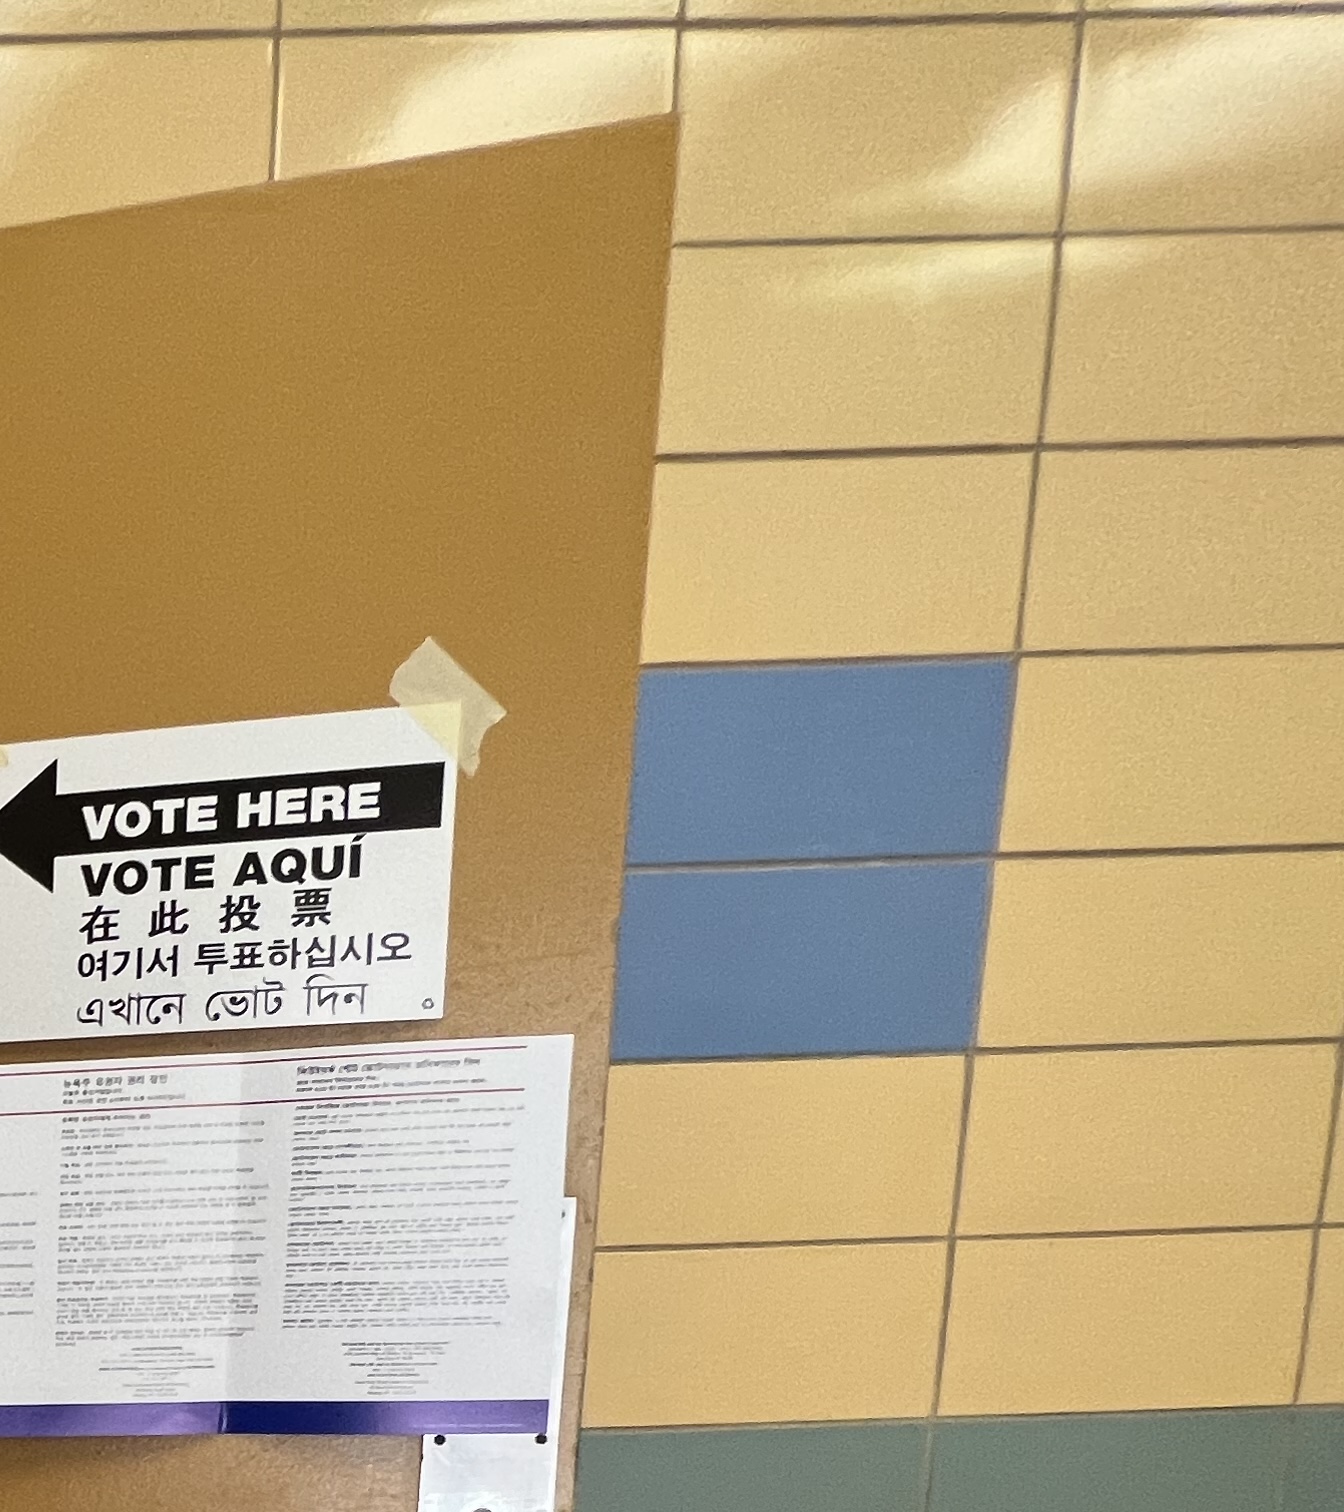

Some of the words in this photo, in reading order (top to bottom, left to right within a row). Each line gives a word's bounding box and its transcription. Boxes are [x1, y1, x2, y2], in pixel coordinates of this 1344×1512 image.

[81, 795, 218, 841] VOTE
[237, 781, 382, 828] HERE
[80, 856, 215, 898] VOTE
[233, 834, 367, 888] AQUÍ
[79, 889, 333, 945] 在此投票
[77, 949, 179, 982] 여기서
[194, 932, 413, 978] 투표하십시오
[76, 991, 187, 1028] এখানে
[205, 977, 286, 1024] ভোট
[305, 974, 369, 1017] দিন
